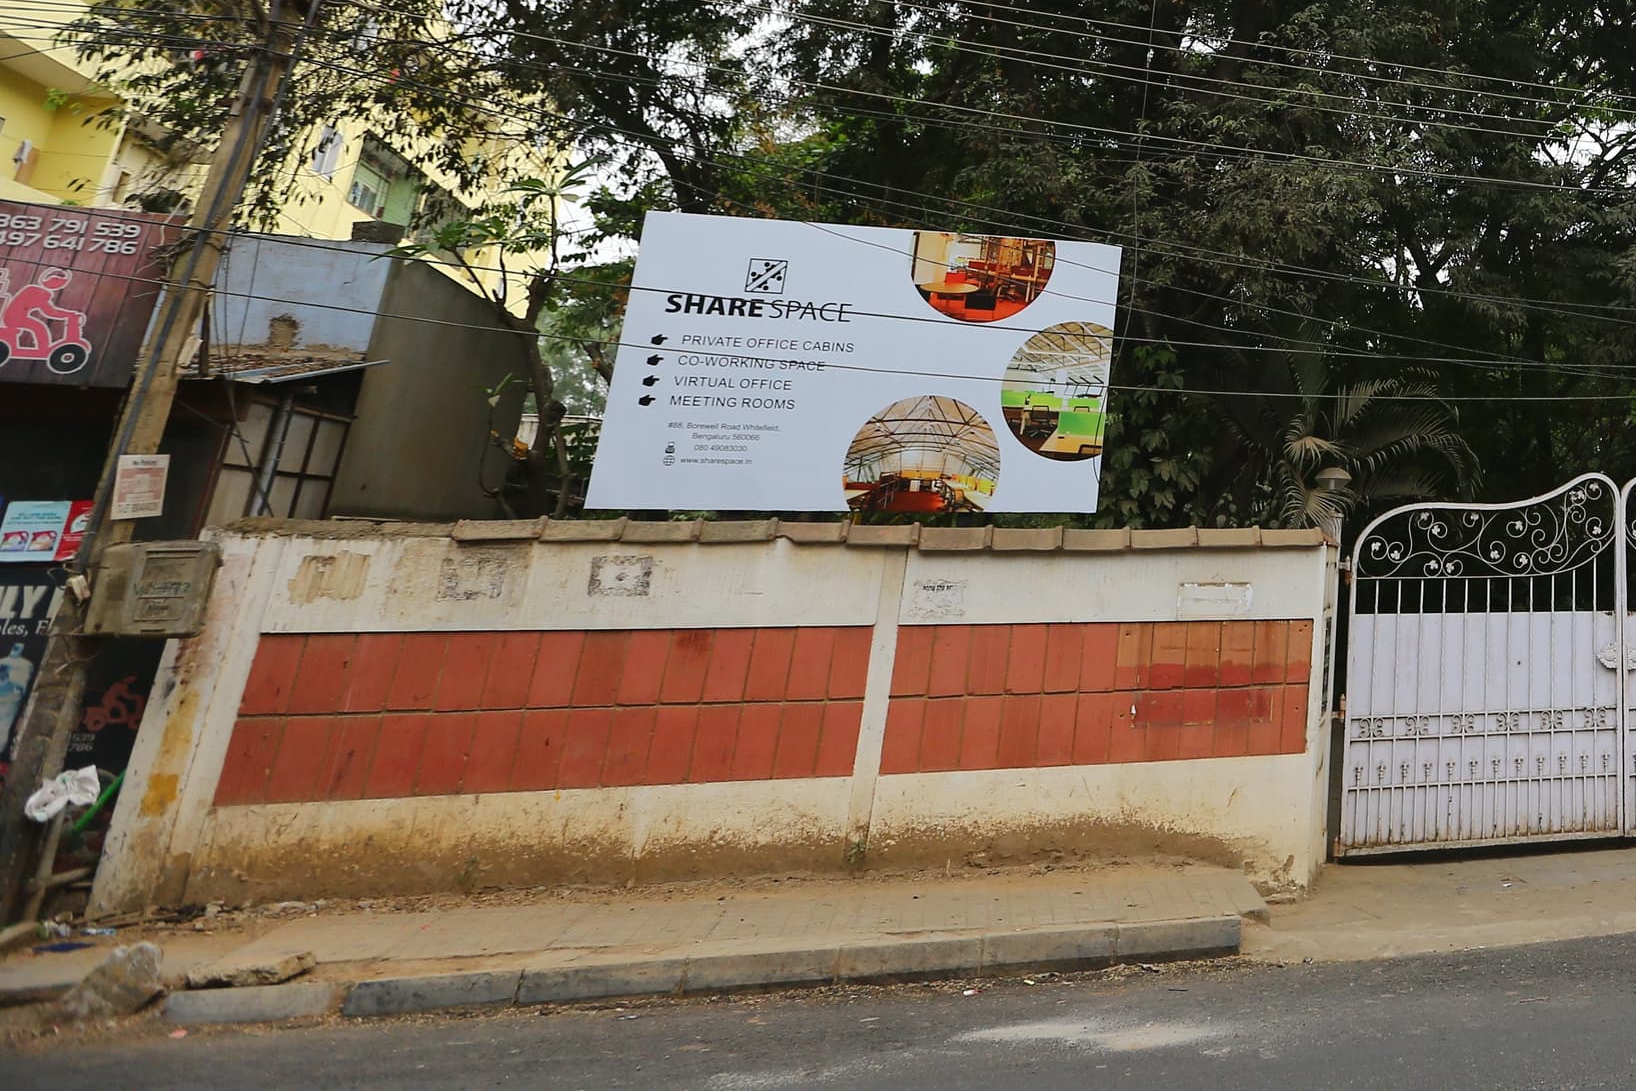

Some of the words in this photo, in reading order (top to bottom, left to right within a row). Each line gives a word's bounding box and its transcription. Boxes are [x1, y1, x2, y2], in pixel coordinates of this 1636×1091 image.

[48, 218, 88, 234] 791
[93, 222, 141, 238] 539
[43, 234, 86, 251] 641
[88, 238, 139, 254] 786
[665, 294, 764, 318] SHARE
[768, 299, 853, 323] SPACE
[682, 334, 742, 348] PRIVATE
[746, 337, 798, 351] OFFICE
[802, 340, 854, 353] CABINS
[678, 355, 775, 370] CO-WORKING
[779, 359, 825, 372] SPACE
[674, 375, 735, 389] VIRTUAL
[739, 378, 792, 391] OFFICE
[669, 395, 737, 408] MEETING
[741, 398, 796, 410] ROOMS
[692, 432, 730, 440] Bengaluru
